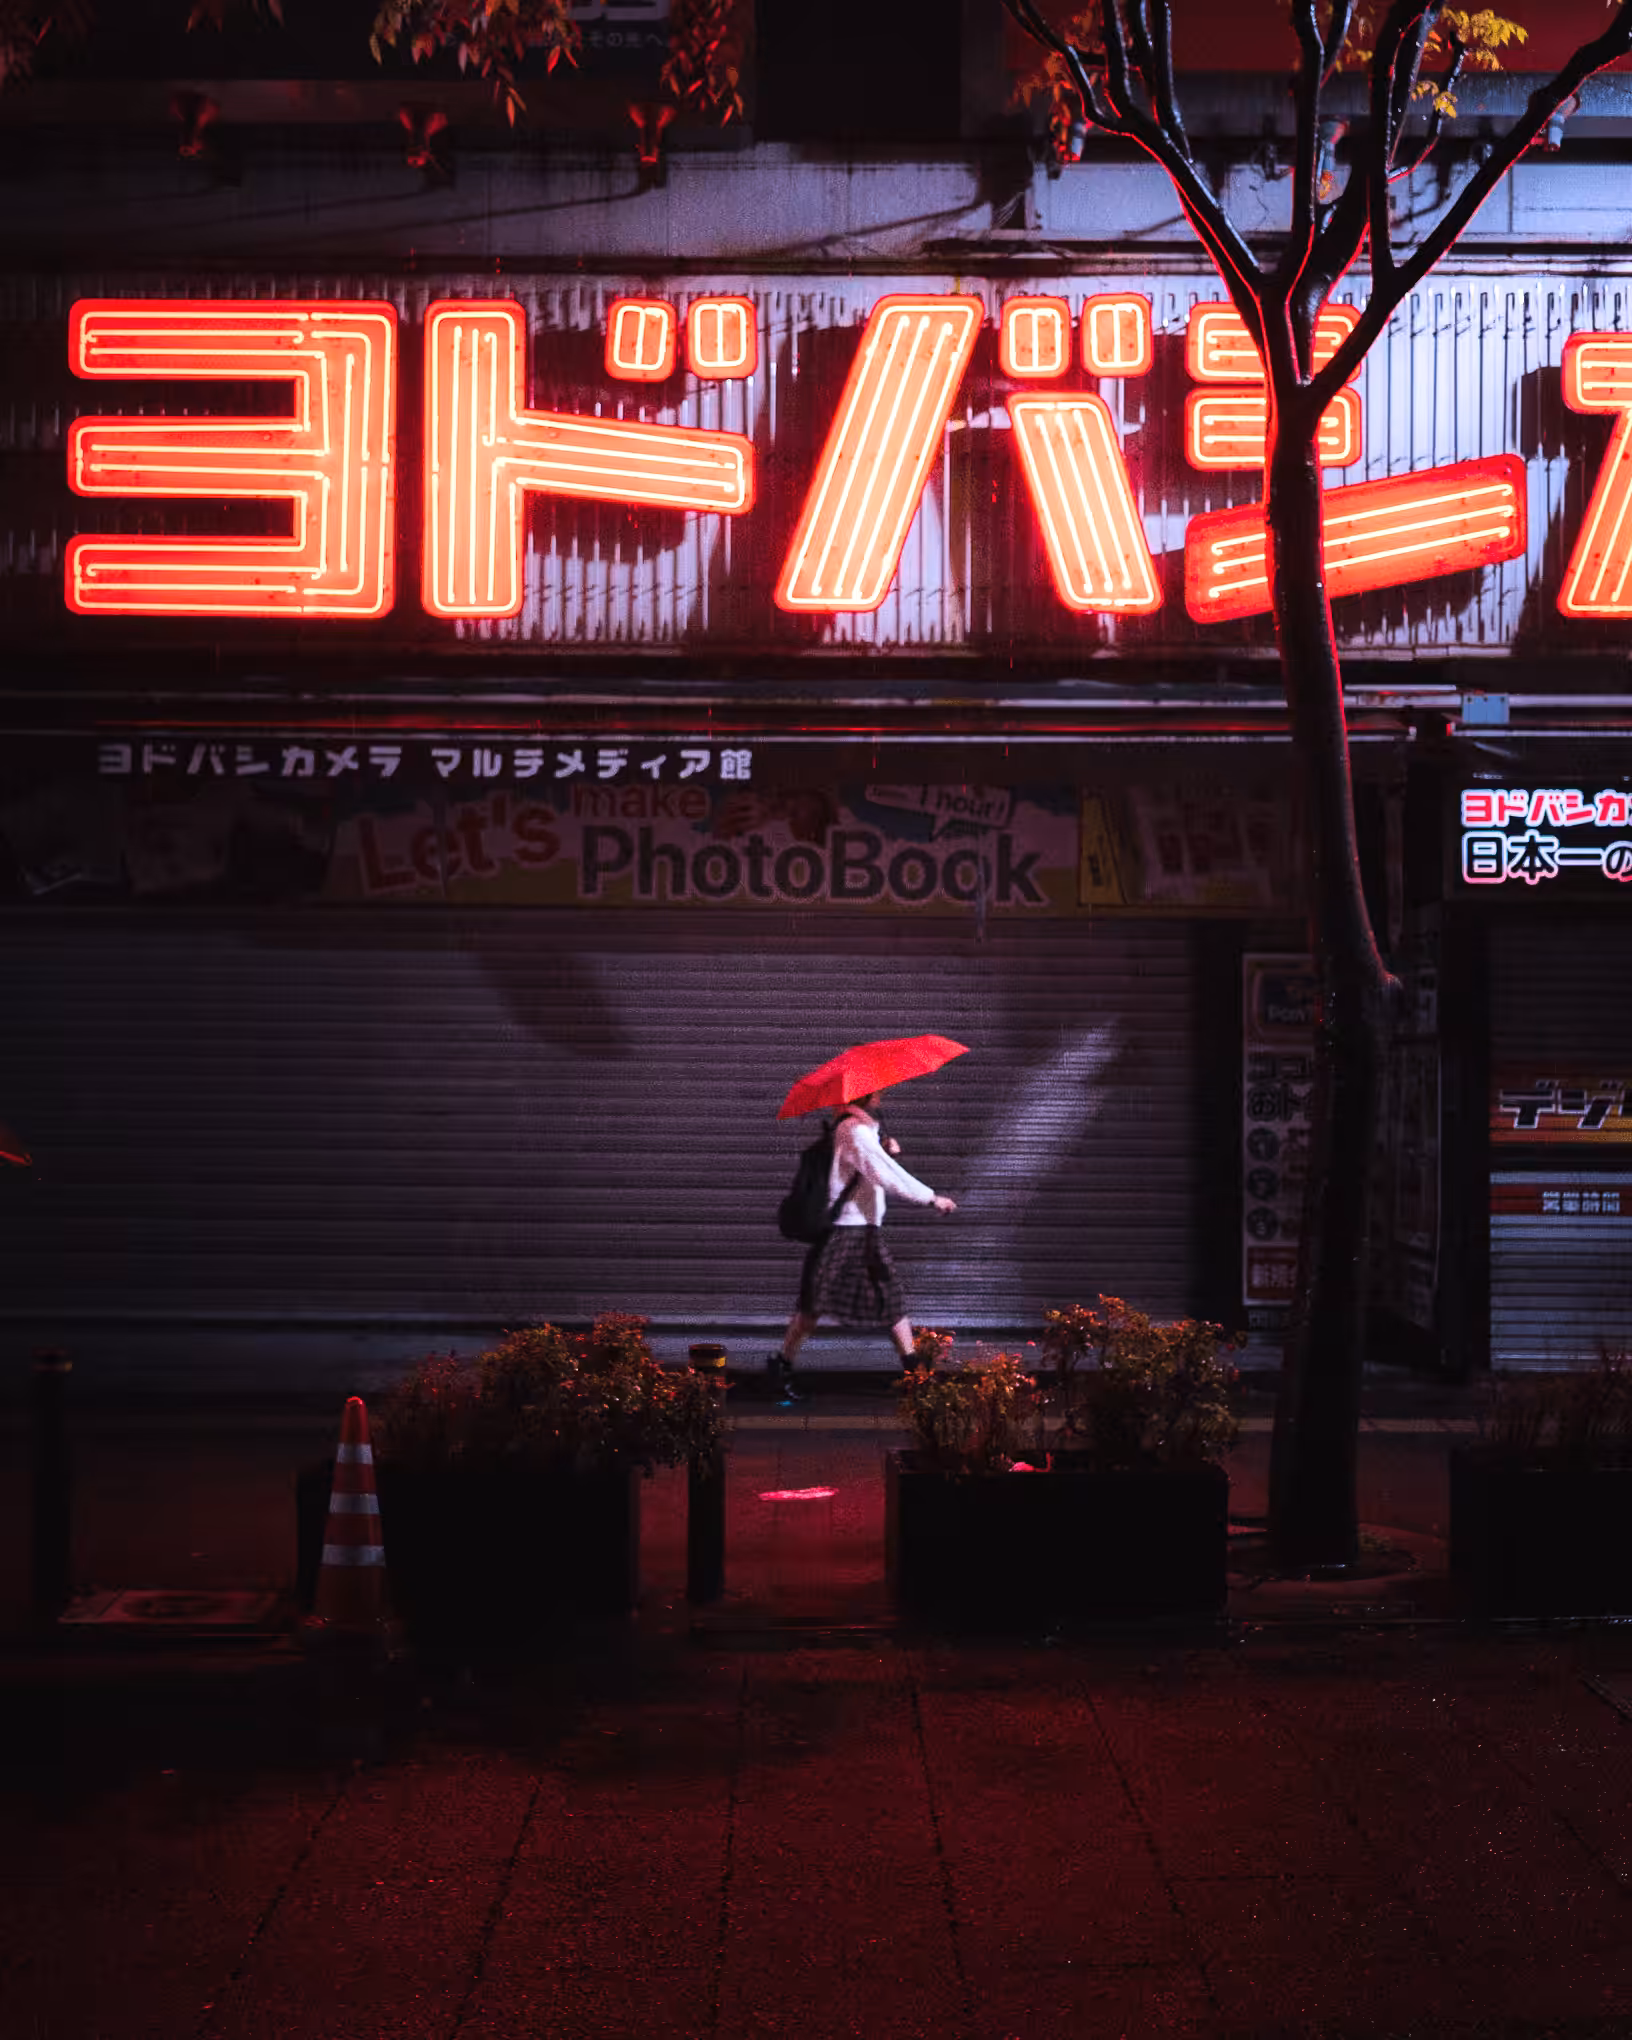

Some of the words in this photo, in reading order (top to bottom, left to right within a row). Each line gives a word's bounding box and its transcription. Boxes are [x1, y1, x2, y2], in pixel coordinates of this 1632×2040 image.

[64, 294, 1632, 623] ヨドバシ
[97, 743, 403, 778] ヨドバシカメラ
[430, 747, 754, 781] マルチメディア館
[573, 783, 712, 820] make
[1461, 789, 1632, 827] ヨドバシカ
[356, 793, 560, 893] Let's
[580, 826, 1044, 902] PhotoBook
[1462, 829, 1632, 885] 日本一の
[1498, 1079, 1632, 1129] デジ
